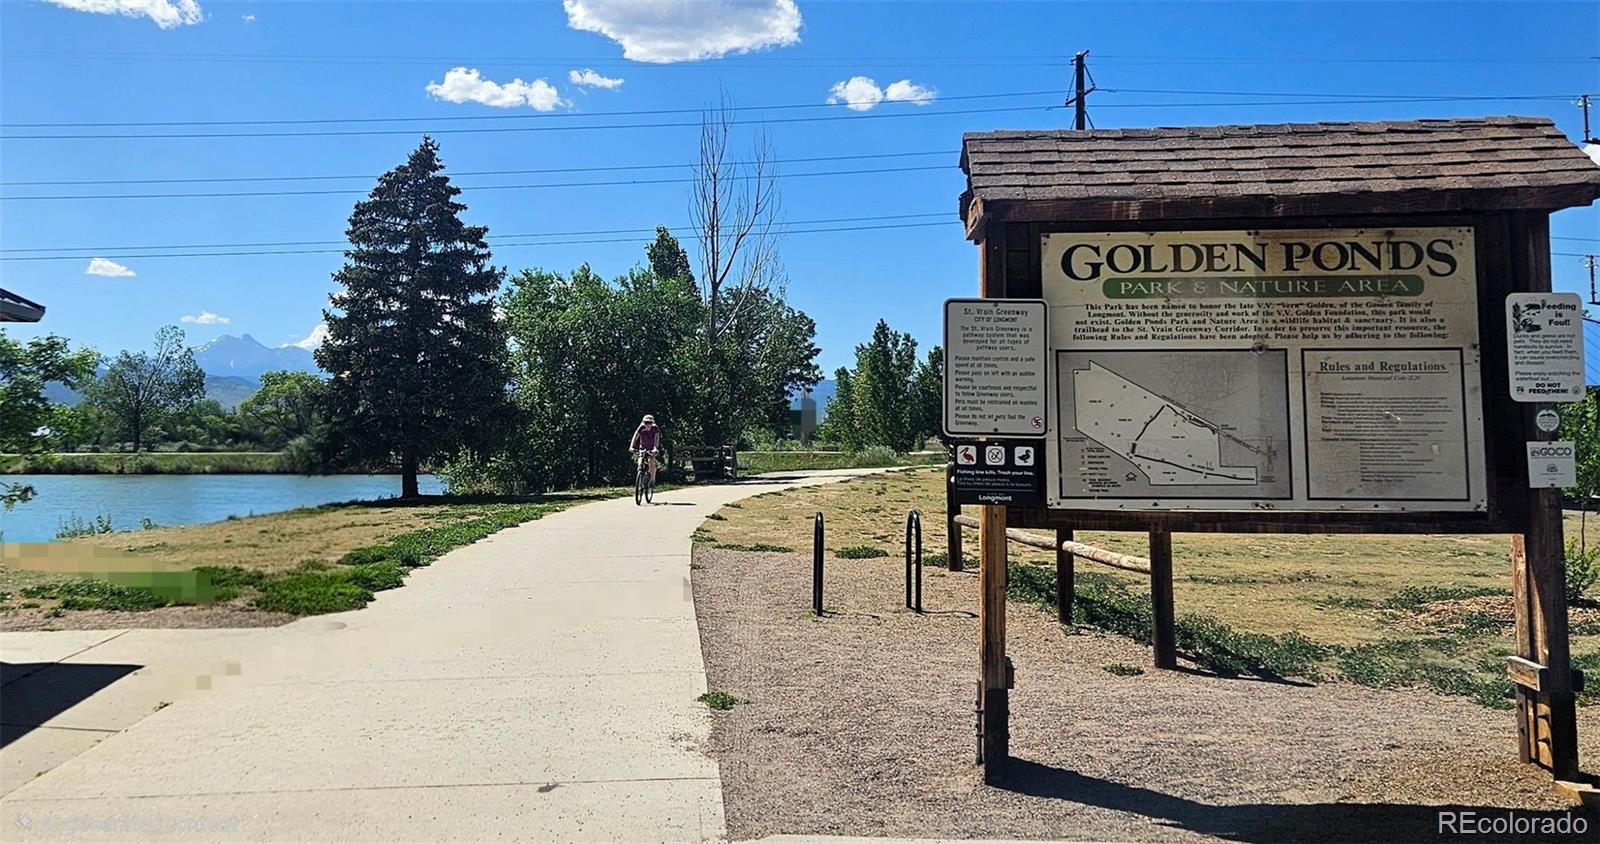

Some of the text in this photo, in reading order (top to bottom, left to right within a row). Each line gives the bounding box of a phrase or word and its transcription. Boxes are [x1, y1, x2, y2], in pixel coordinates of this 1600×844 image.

[1060, 239, 1457, 281] GOLDEN PONDS
[1120, 279, 1409, 294] PARK & NATURE AREA
[1396, 301, 1421, 309] family
[1541, 303, 1576, 311] Feeding
[996, 308, 1029, 317] Greenway
[1088, 311, 1126, 319] Longmont.
[1176, 310, 1212, 318] generosity
[1389, 309, 1406, 317] park
[1354, 317, 1396, 325] sanctuary.
[1352, 325, 1391, 333] important
[1073, 334, 1107, 342] following
[1240, 333, 1271, 341] adopted.
[1302, 333, 1319, 341] help
[1334, 333, 1342, 341] by
[1320, 361, 1446, 372] Rules and Regulations
[1540, 447, 1572, 456] GOCO
